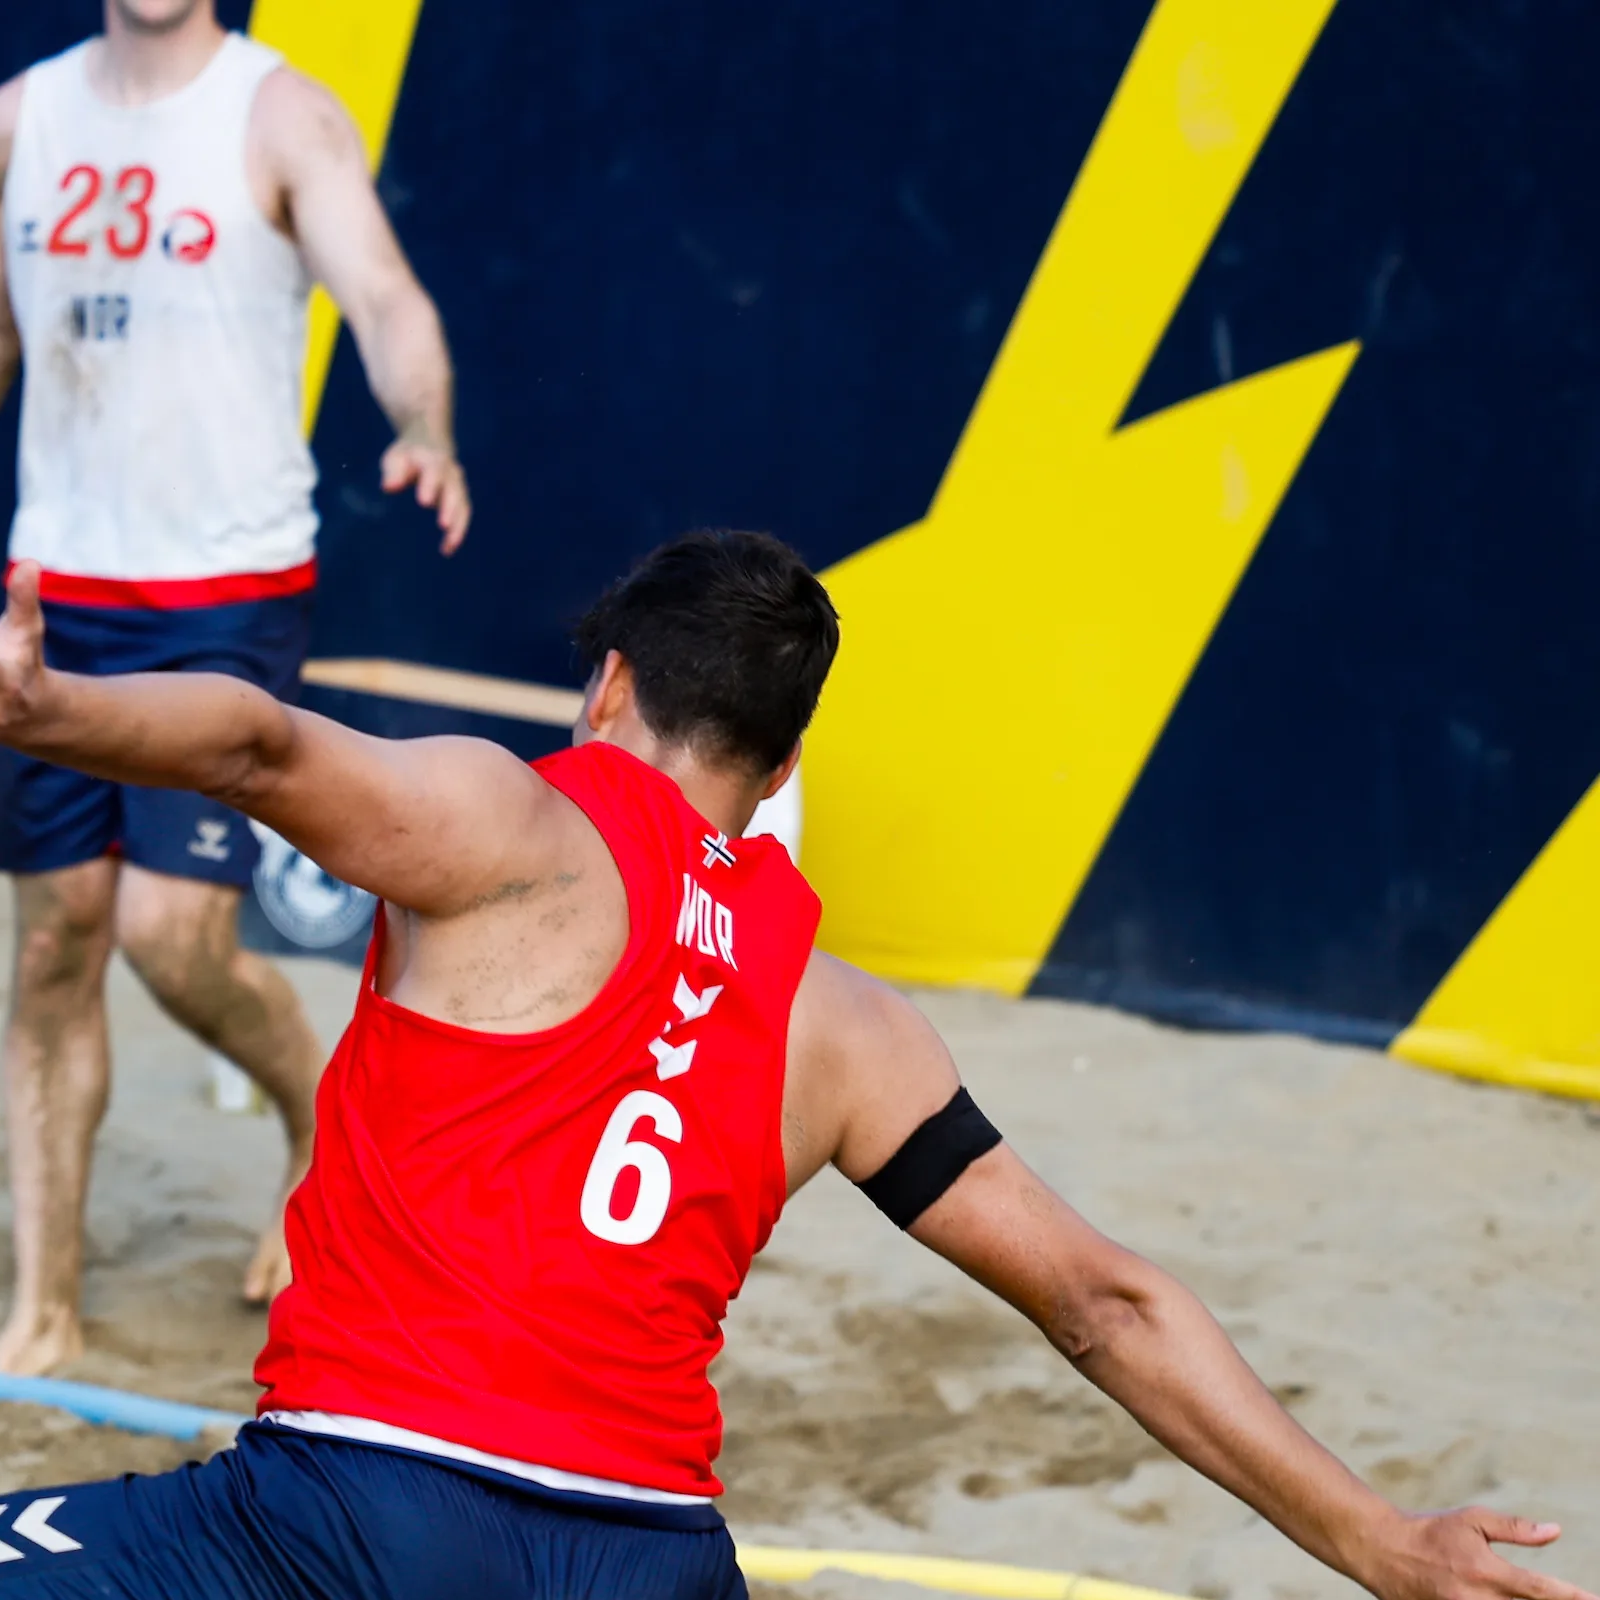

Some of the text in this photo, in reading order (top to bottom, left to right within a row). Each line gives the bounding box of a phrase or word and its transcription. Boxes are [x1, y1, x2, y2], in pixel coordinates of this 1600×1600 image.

[47, 162, 157, 262] 23
[675, 871, 739, 972] NOR
[579, 1089, 683, 1246] 6
